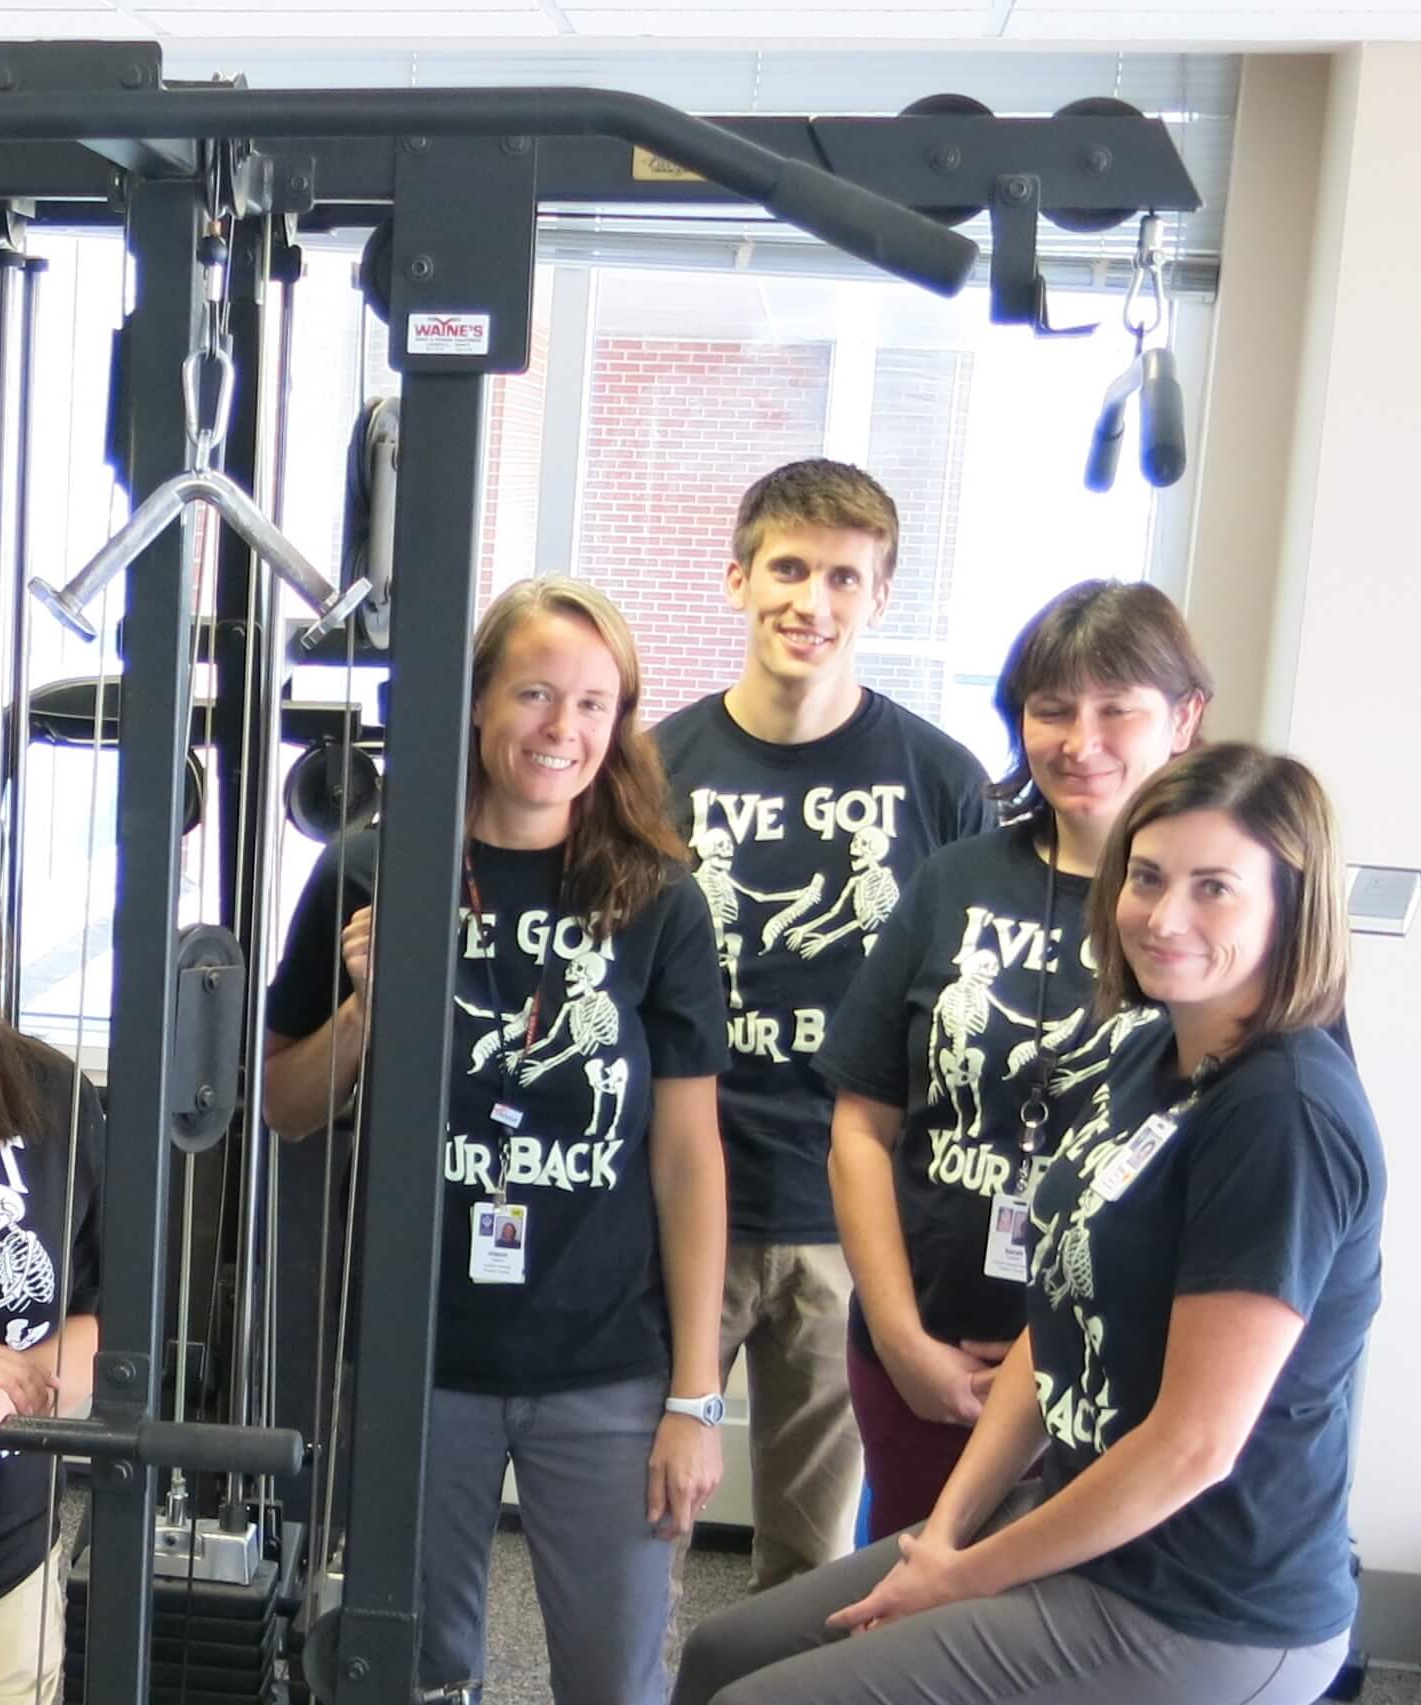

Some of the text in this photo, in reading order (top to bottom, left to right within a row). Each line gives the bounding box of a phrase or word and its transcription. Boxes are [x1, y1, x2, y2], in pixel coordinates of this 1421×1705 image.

[415, 317, 484, 338] WAYNE'S
[688, 784, 906, 848] I'VE GOT
[516, 908, 623, 966] GOT
[951, 905, 1063, 974] I'VE
[727, 1010, 791, 1064] UR
[444, 1133, 624, 1194] UR BACK
[927, 1129, 1010, 1198] YOUR
